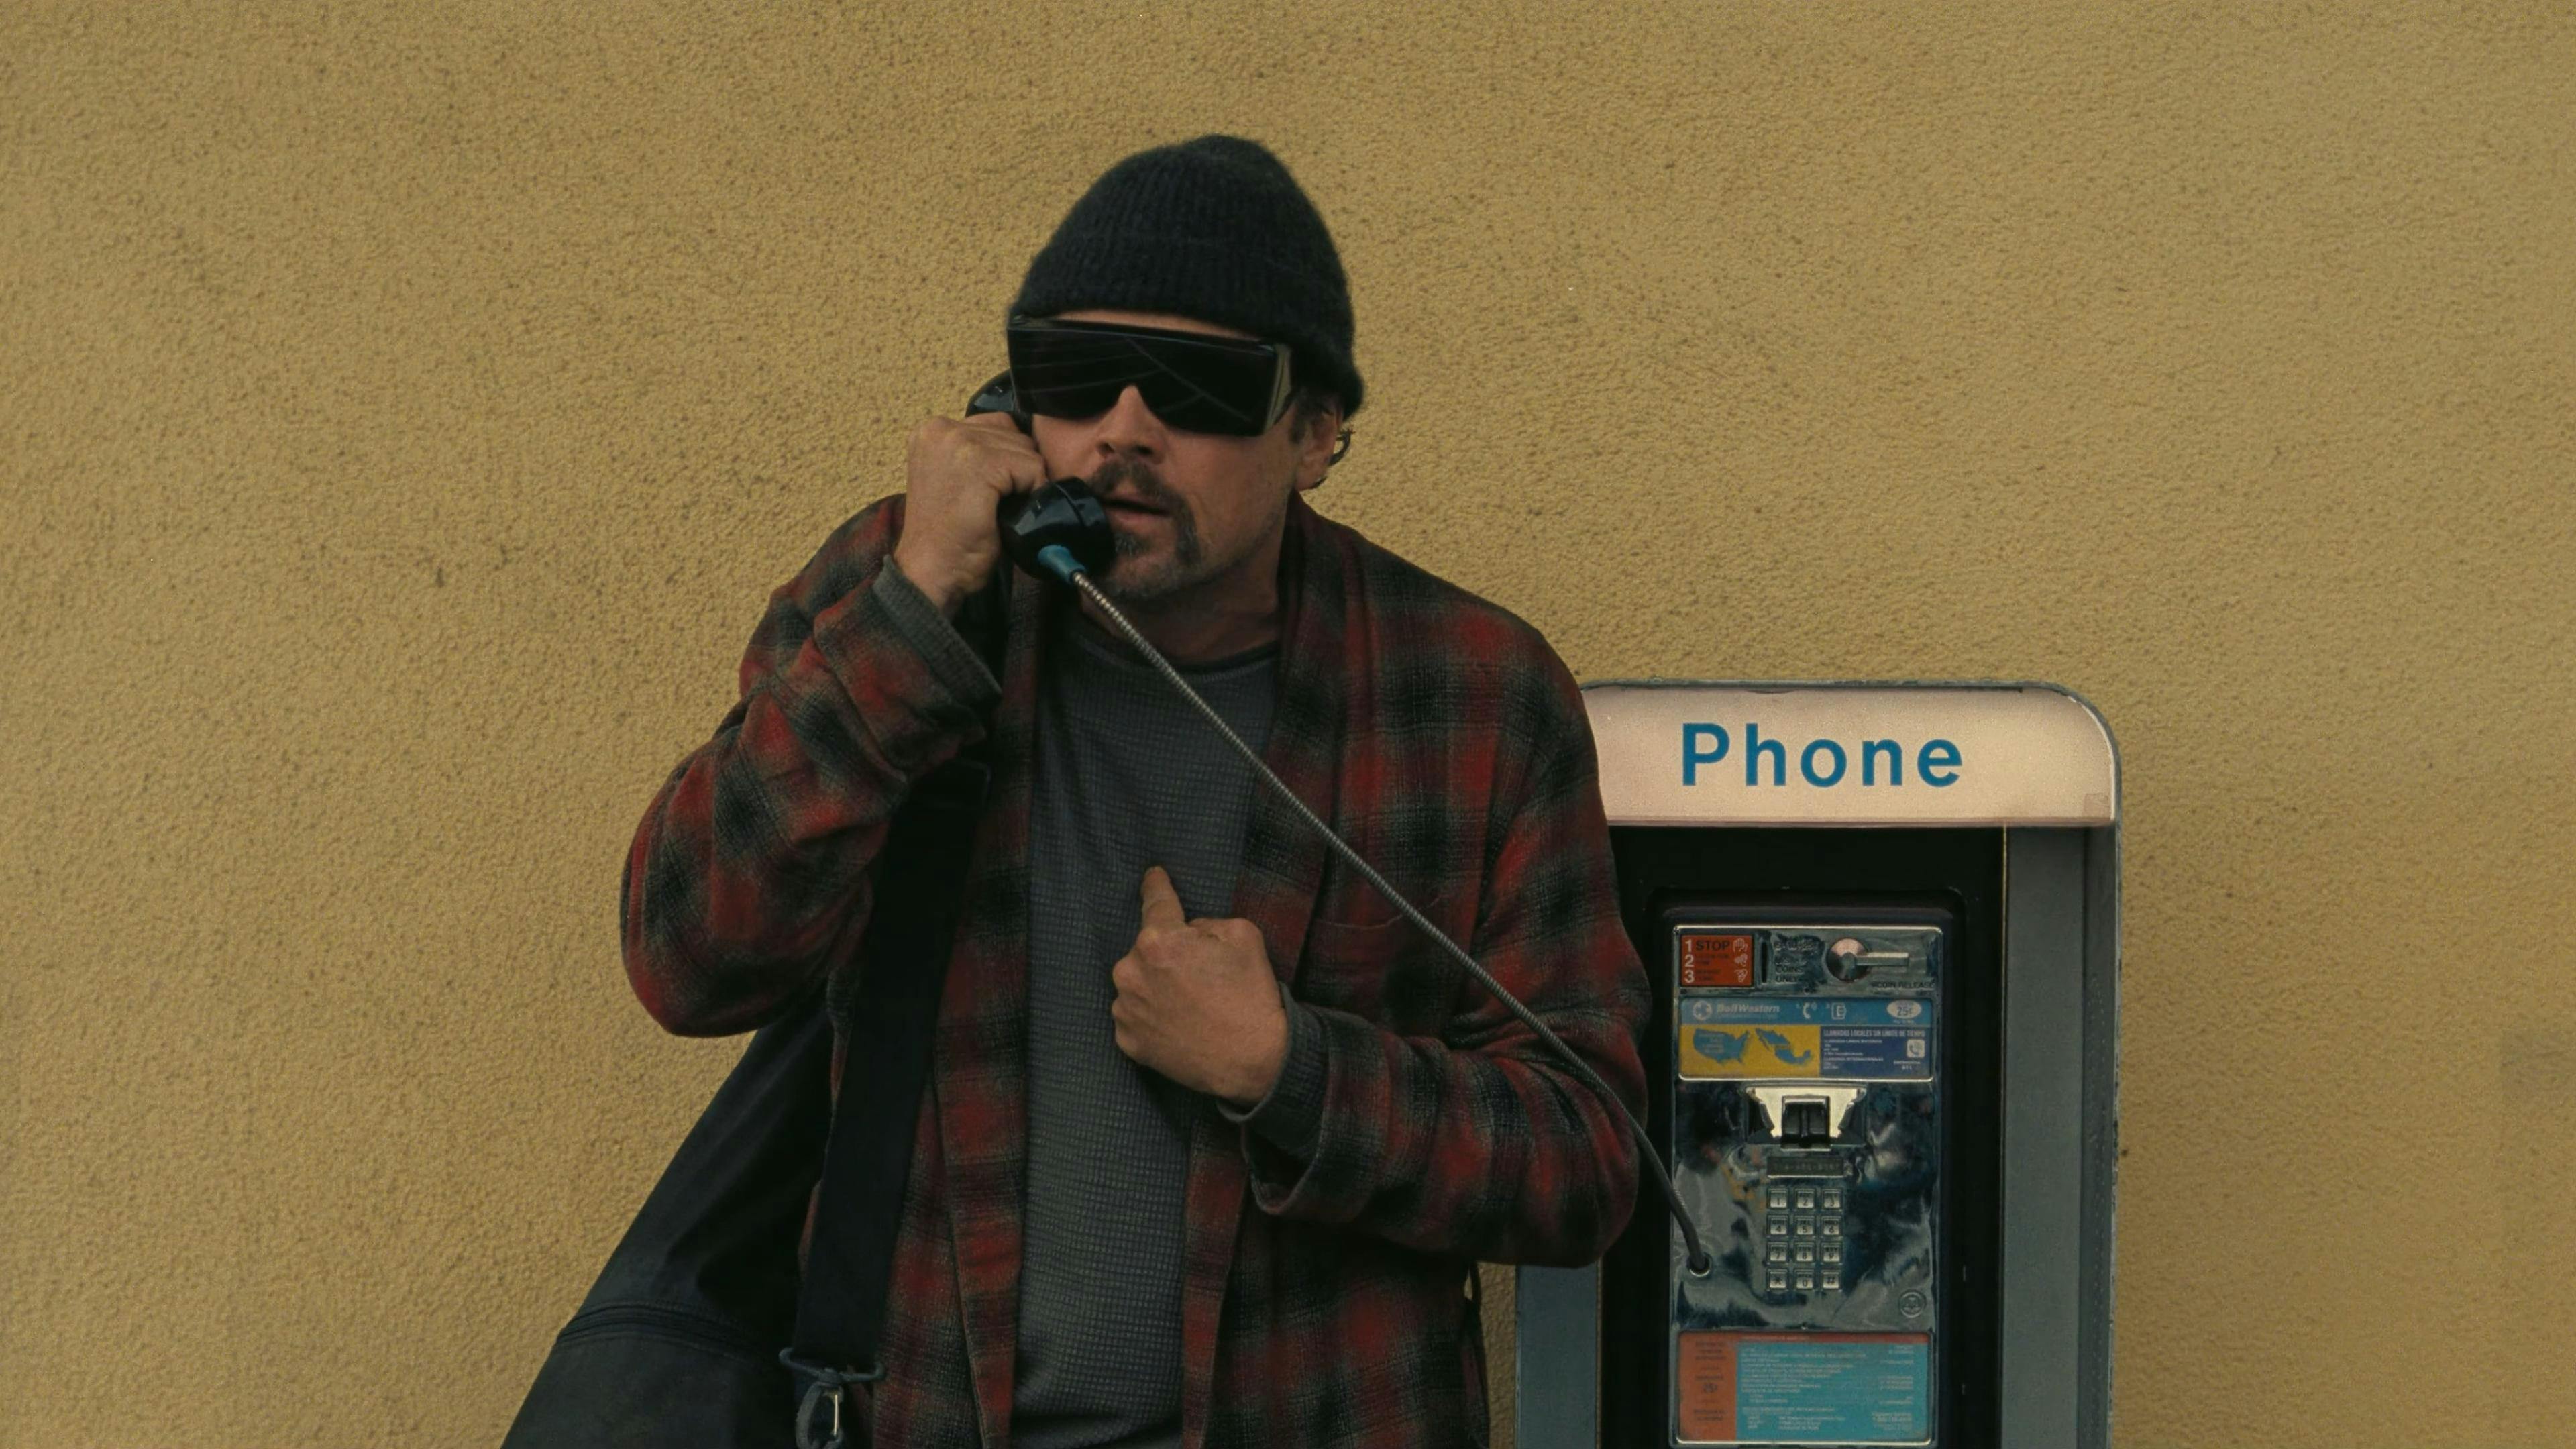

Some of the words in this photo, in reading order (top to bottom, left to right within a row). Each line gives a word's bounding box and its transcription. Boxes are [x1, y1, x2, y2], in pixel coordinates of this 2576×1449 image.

[1682, 722, 1963, 787] Phone
[1685, 939, 1692, 952] 1
[1696, 940, 1730, 951] STOP
[1685, 955, 1694, 967] 2
[1684, 970, 1695, 983] 3
[1803, 1198, 1808, 1206] 2
[1802, 1225, 1808, 1233] 5
